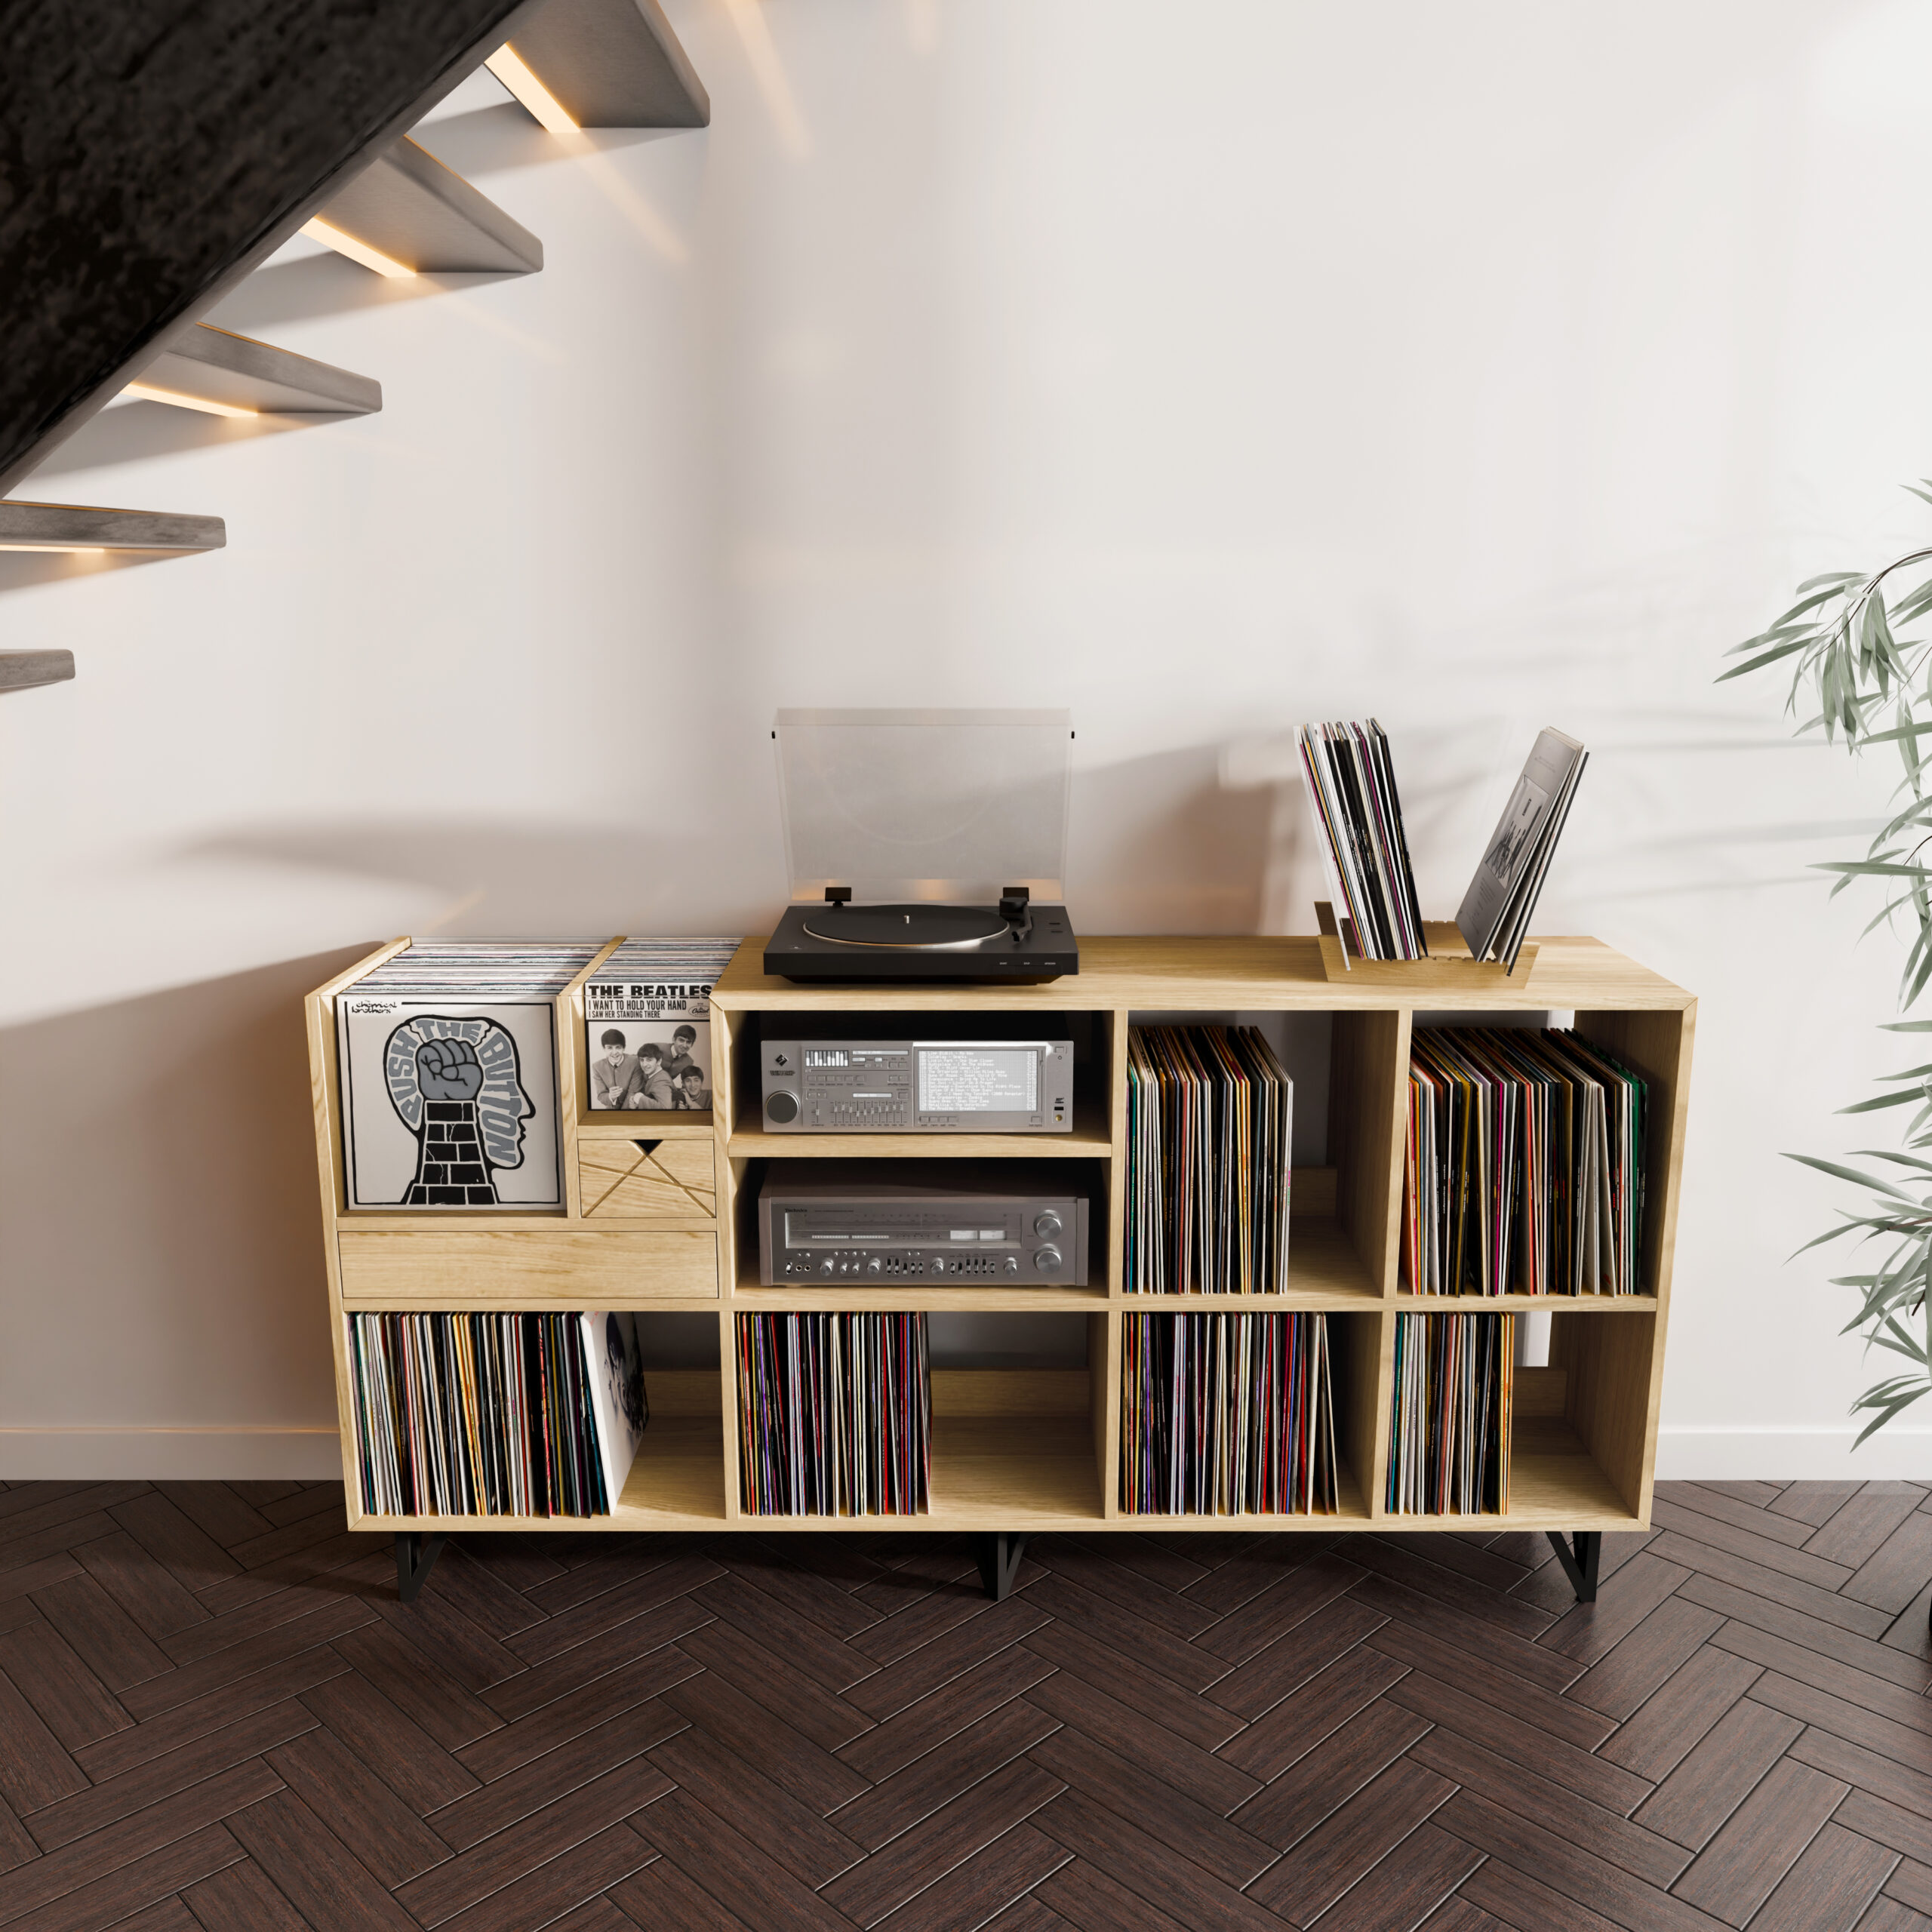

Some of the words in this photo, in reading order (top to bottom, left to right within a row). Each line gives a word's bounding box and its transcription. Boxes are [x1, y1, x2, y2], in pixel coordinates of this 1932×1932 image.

[588, 985, 624, 999] THE
[631, 985, 712, 999] BEATLES
[593, 1000, 613, 1010] WANT
[616, 1000, 624, 1010] TO
[627, 1000, 644, 1010] HOLD
[647, 1000, 665, 1010] YOUR
[668, 1000, 686, 1010] HAND
[388, 1029, 422, 1124] PUSH
[415, 1020, 481, 1044] THE
[478, 1032, 522, 1164] BUTTON
